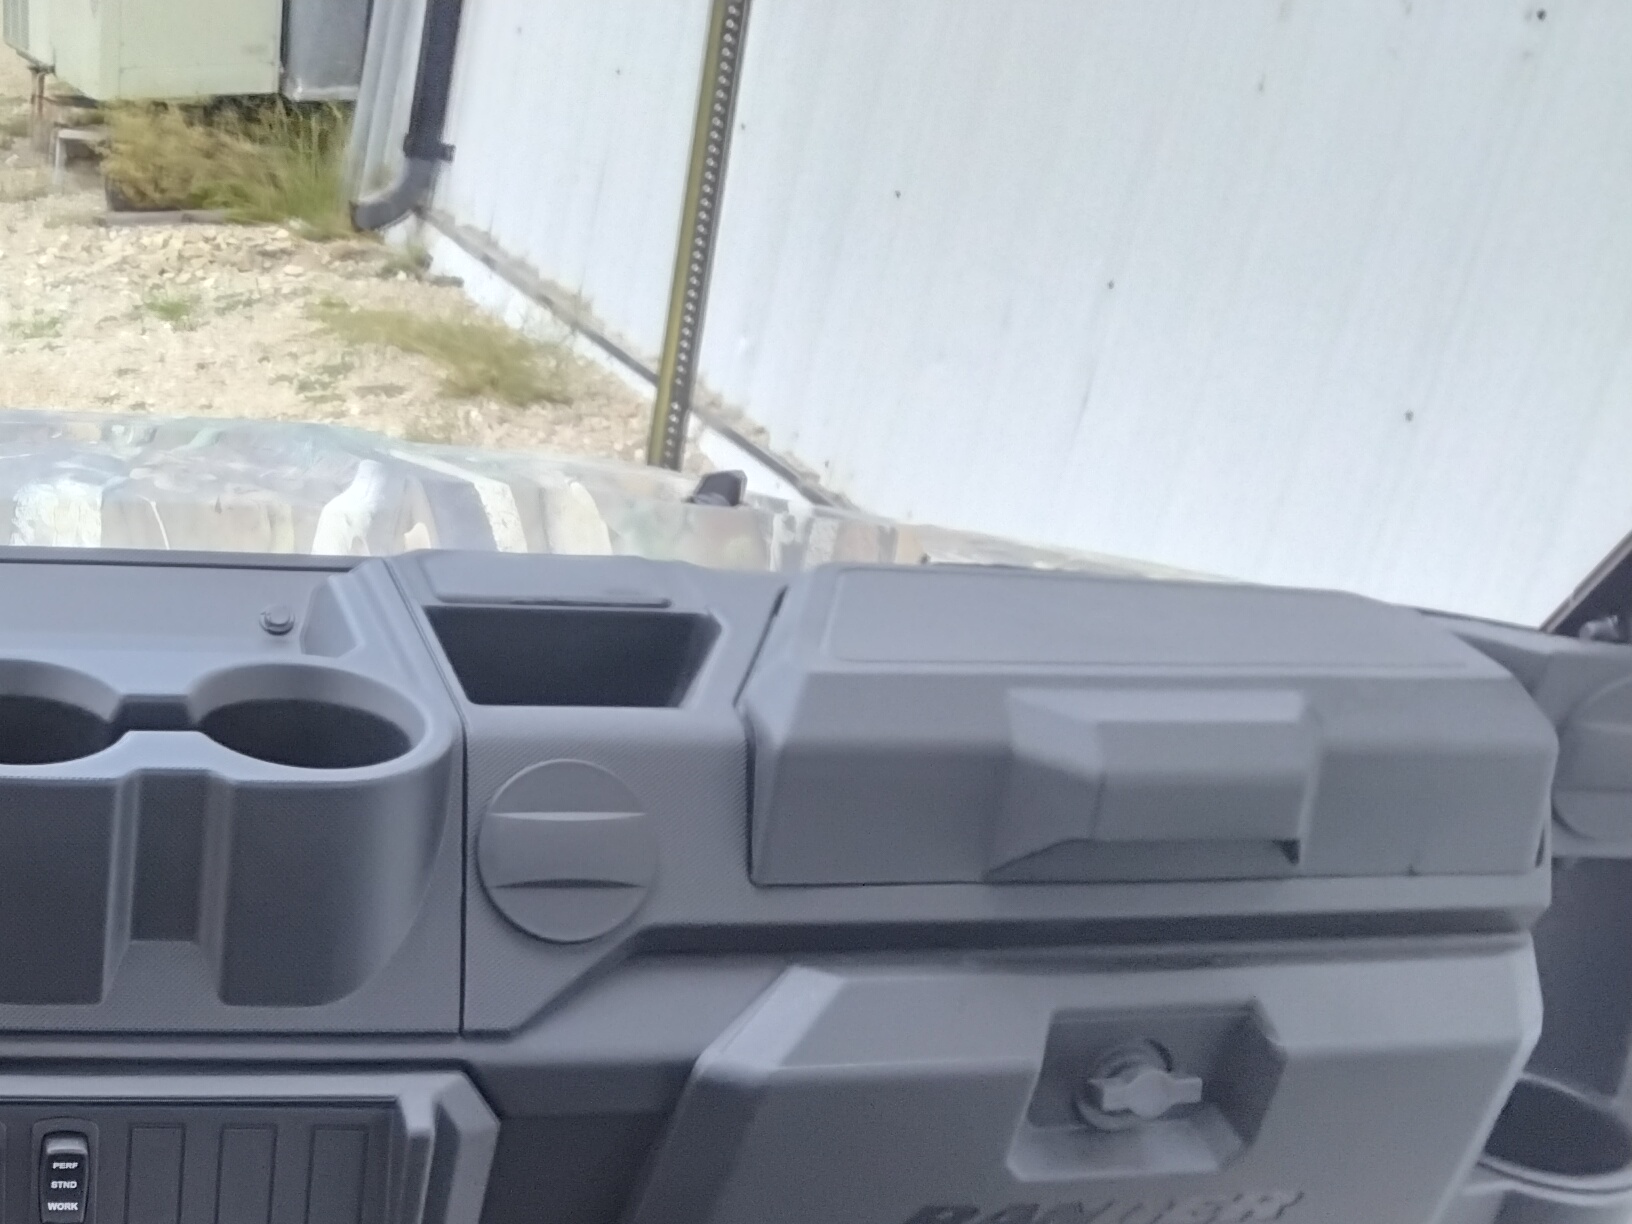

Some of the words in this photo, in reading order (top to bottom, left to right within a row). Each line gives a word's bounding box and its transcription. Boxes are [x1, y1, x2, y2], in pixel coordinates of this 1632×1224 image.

[52, 1161, 78, 1170] PERF
[50, 1180, 78, 1189] STND
[47, 1202, 79, 1211] WORK
